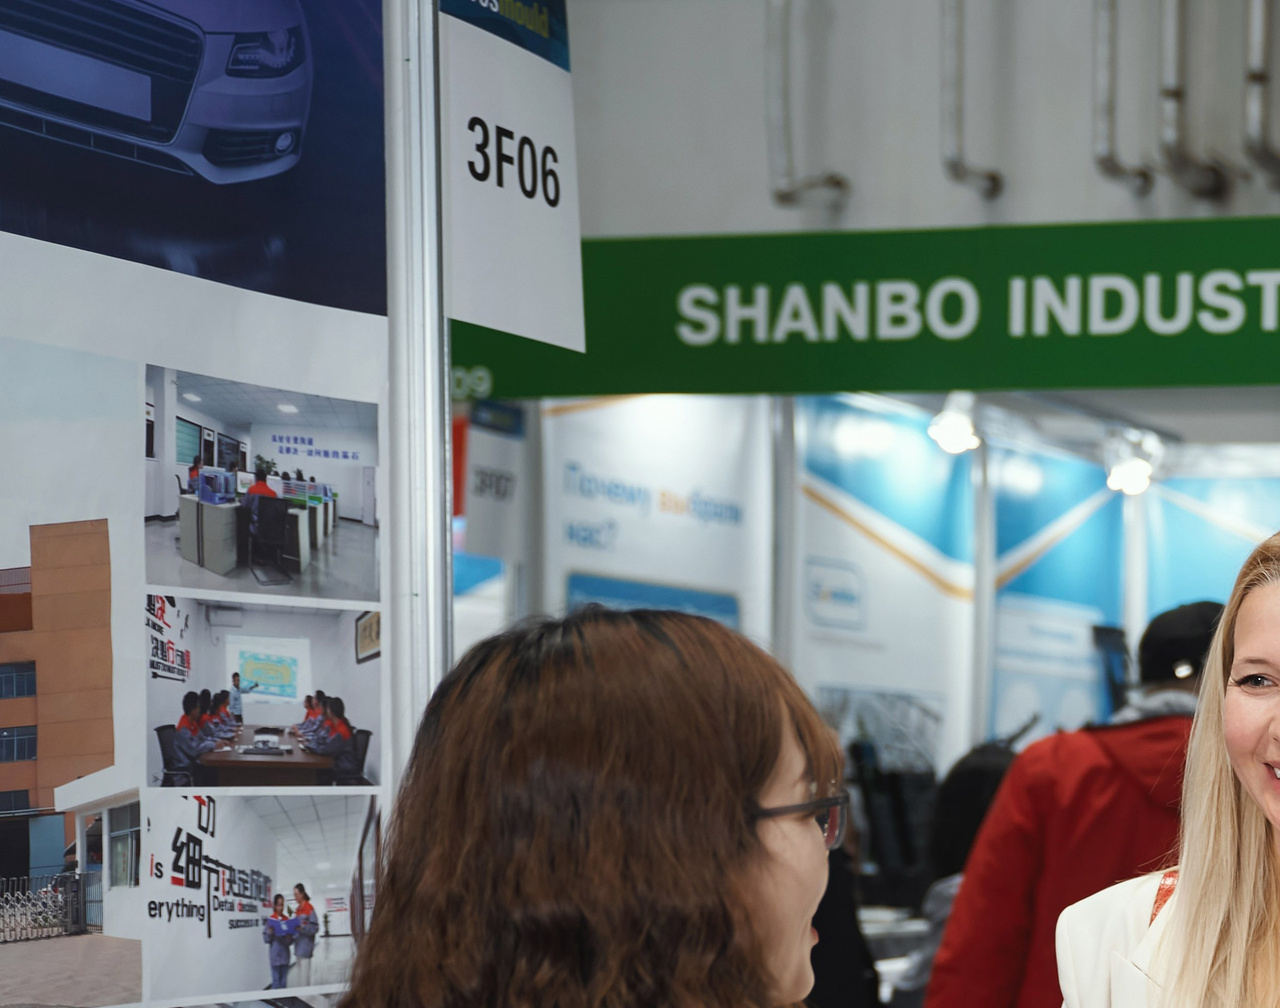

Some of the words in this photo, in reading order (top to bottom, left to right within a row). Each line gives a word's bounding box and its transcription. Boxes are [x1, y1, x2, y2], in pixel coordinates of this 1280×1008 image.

[467, 116, 560, 208] 3F06
[676, 276, 981, 346] SHANBO
[150, 853, 164, 879] is
